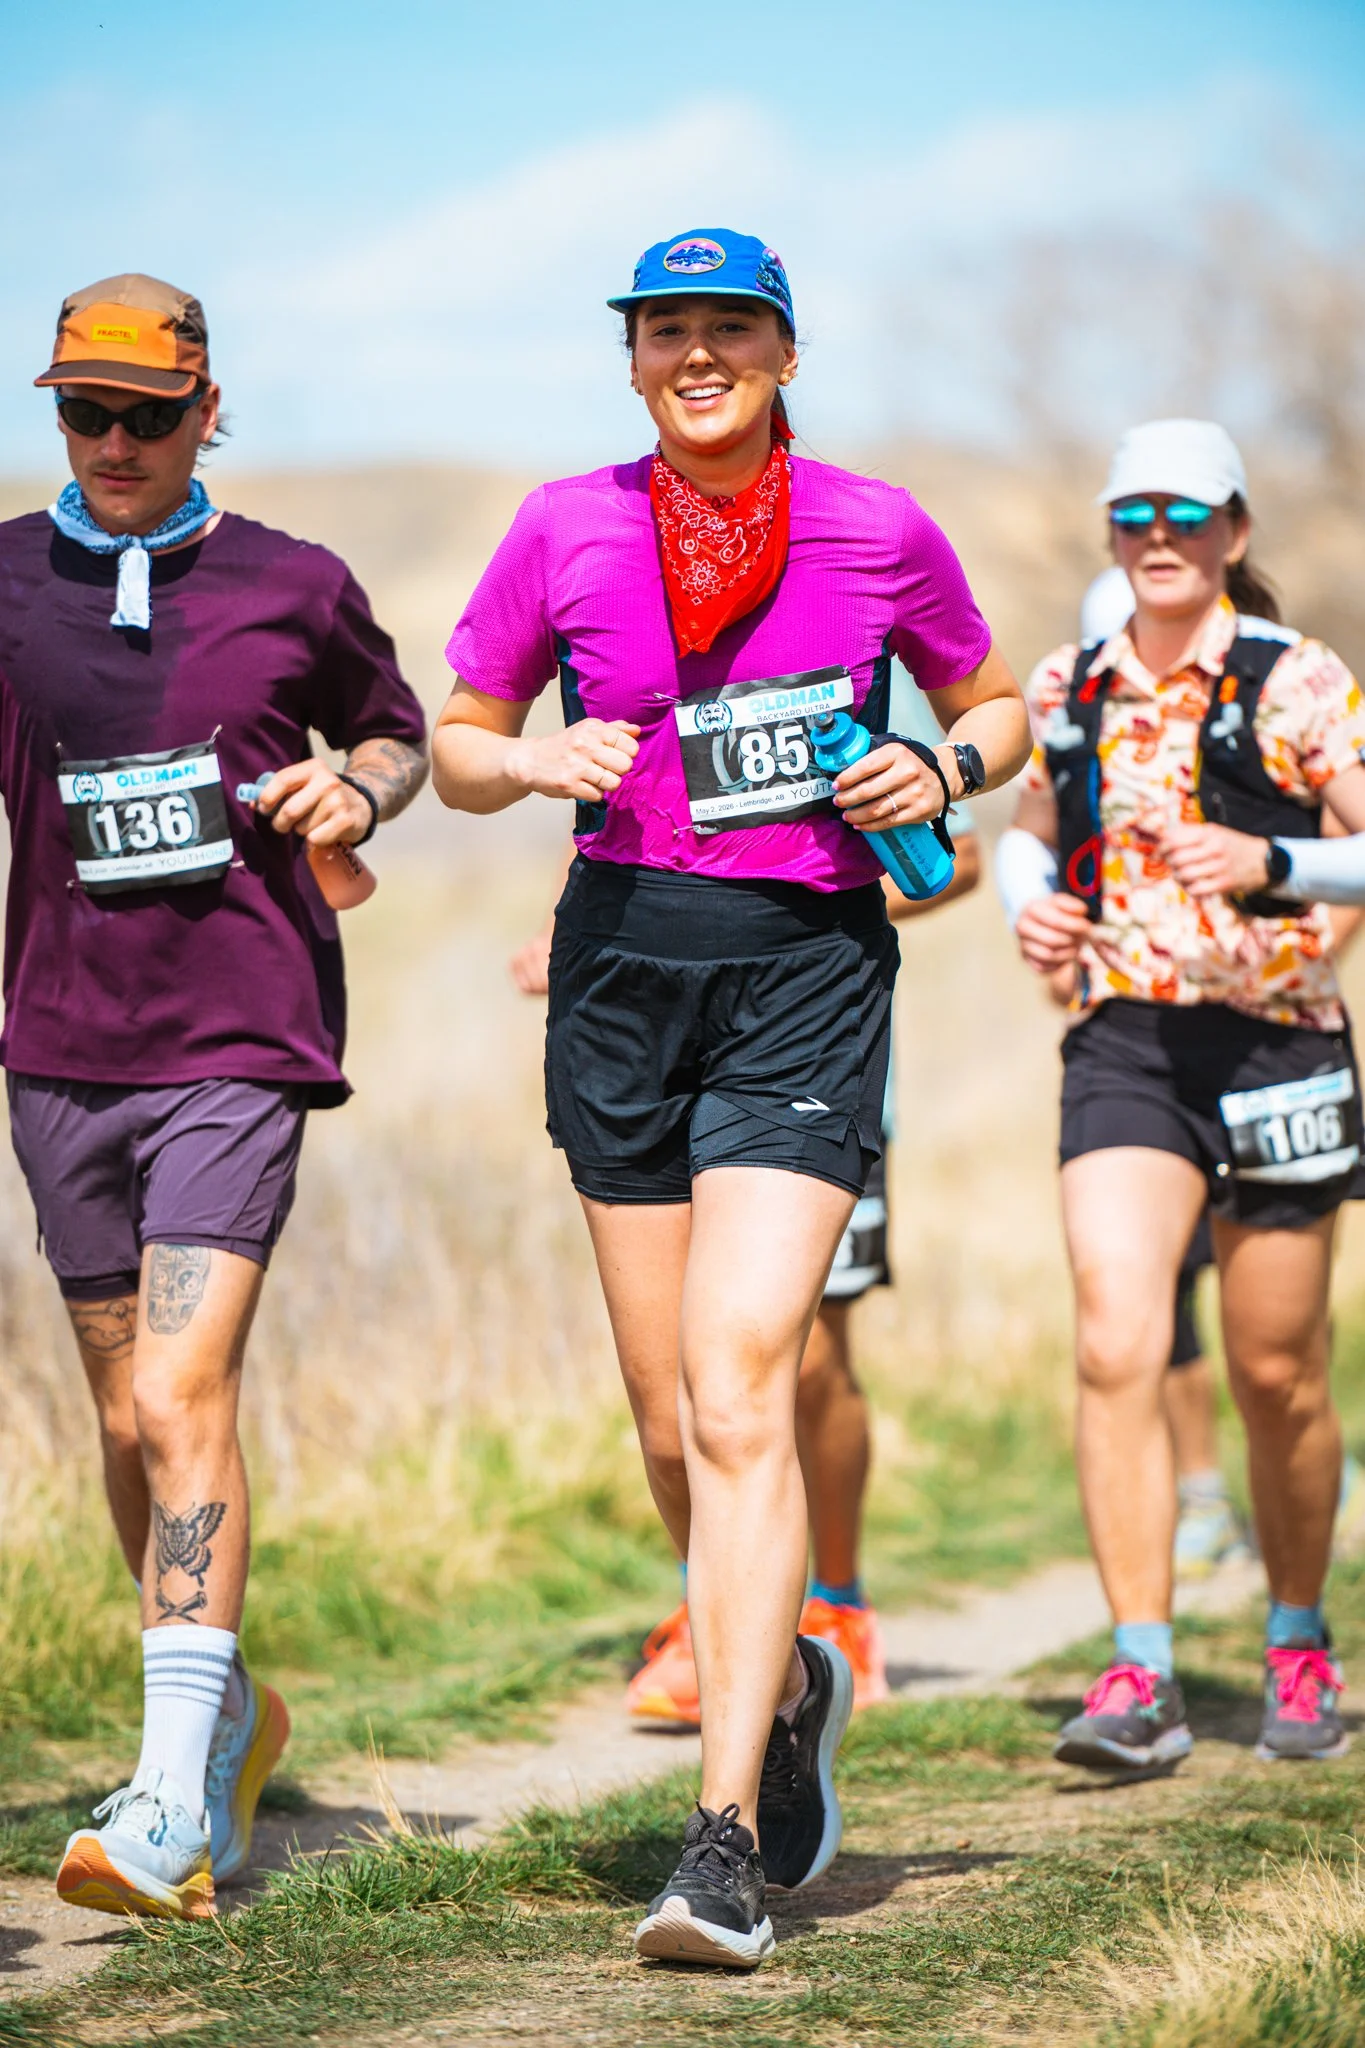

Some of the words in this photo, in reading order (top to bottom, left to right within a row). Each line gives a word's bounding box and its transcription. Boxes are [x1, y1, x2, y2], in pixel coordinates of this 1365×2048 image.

[749, 684, 835, 713] OLDMAN
[757, 709, 801, 723] BACKYARD
[804, 703, 831, 714] ULTRA
[740, 725, 809, 782] 85
[116, 763, 198, 787] OLDMAN
[775, 793, 785, 801] AB
[95, 796, 193, 852] 136
[1262, 1105, 1342, 1162] 106
